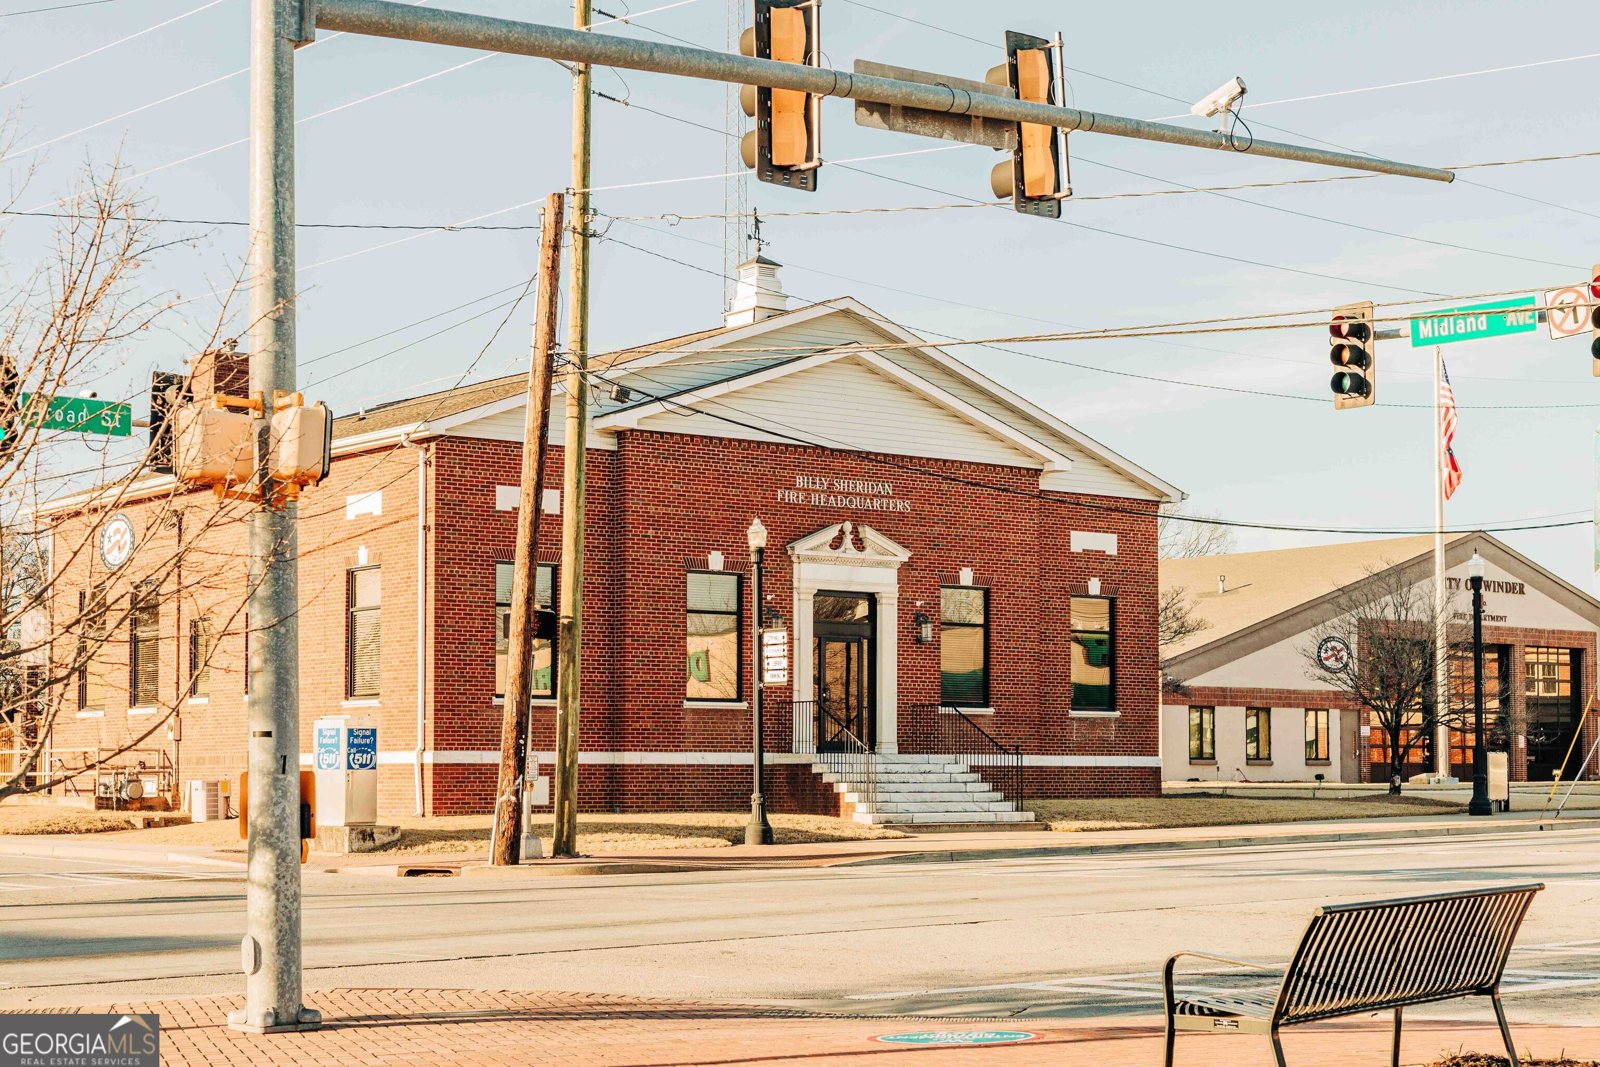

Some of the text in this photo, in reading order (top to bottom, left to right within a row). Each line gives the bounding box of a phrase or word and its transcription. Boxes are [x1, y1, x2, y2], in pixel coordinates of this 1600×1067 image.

[1418, 304, 1535, 339] Midland AVE
[101, 409, 121, 428] St
[795, 476, 893, 496] BILLY SHERIDAN
[777, 489, 911, 513] FIRE HEADQUARTERS
[1483, 580, 1526, 595] WINDER
[349, 736, 374, 744] Failure?
[352, 728, 371, 738] Signal
[322, 753, 336, 765] 511
[354, 753, 371, 765] 511
